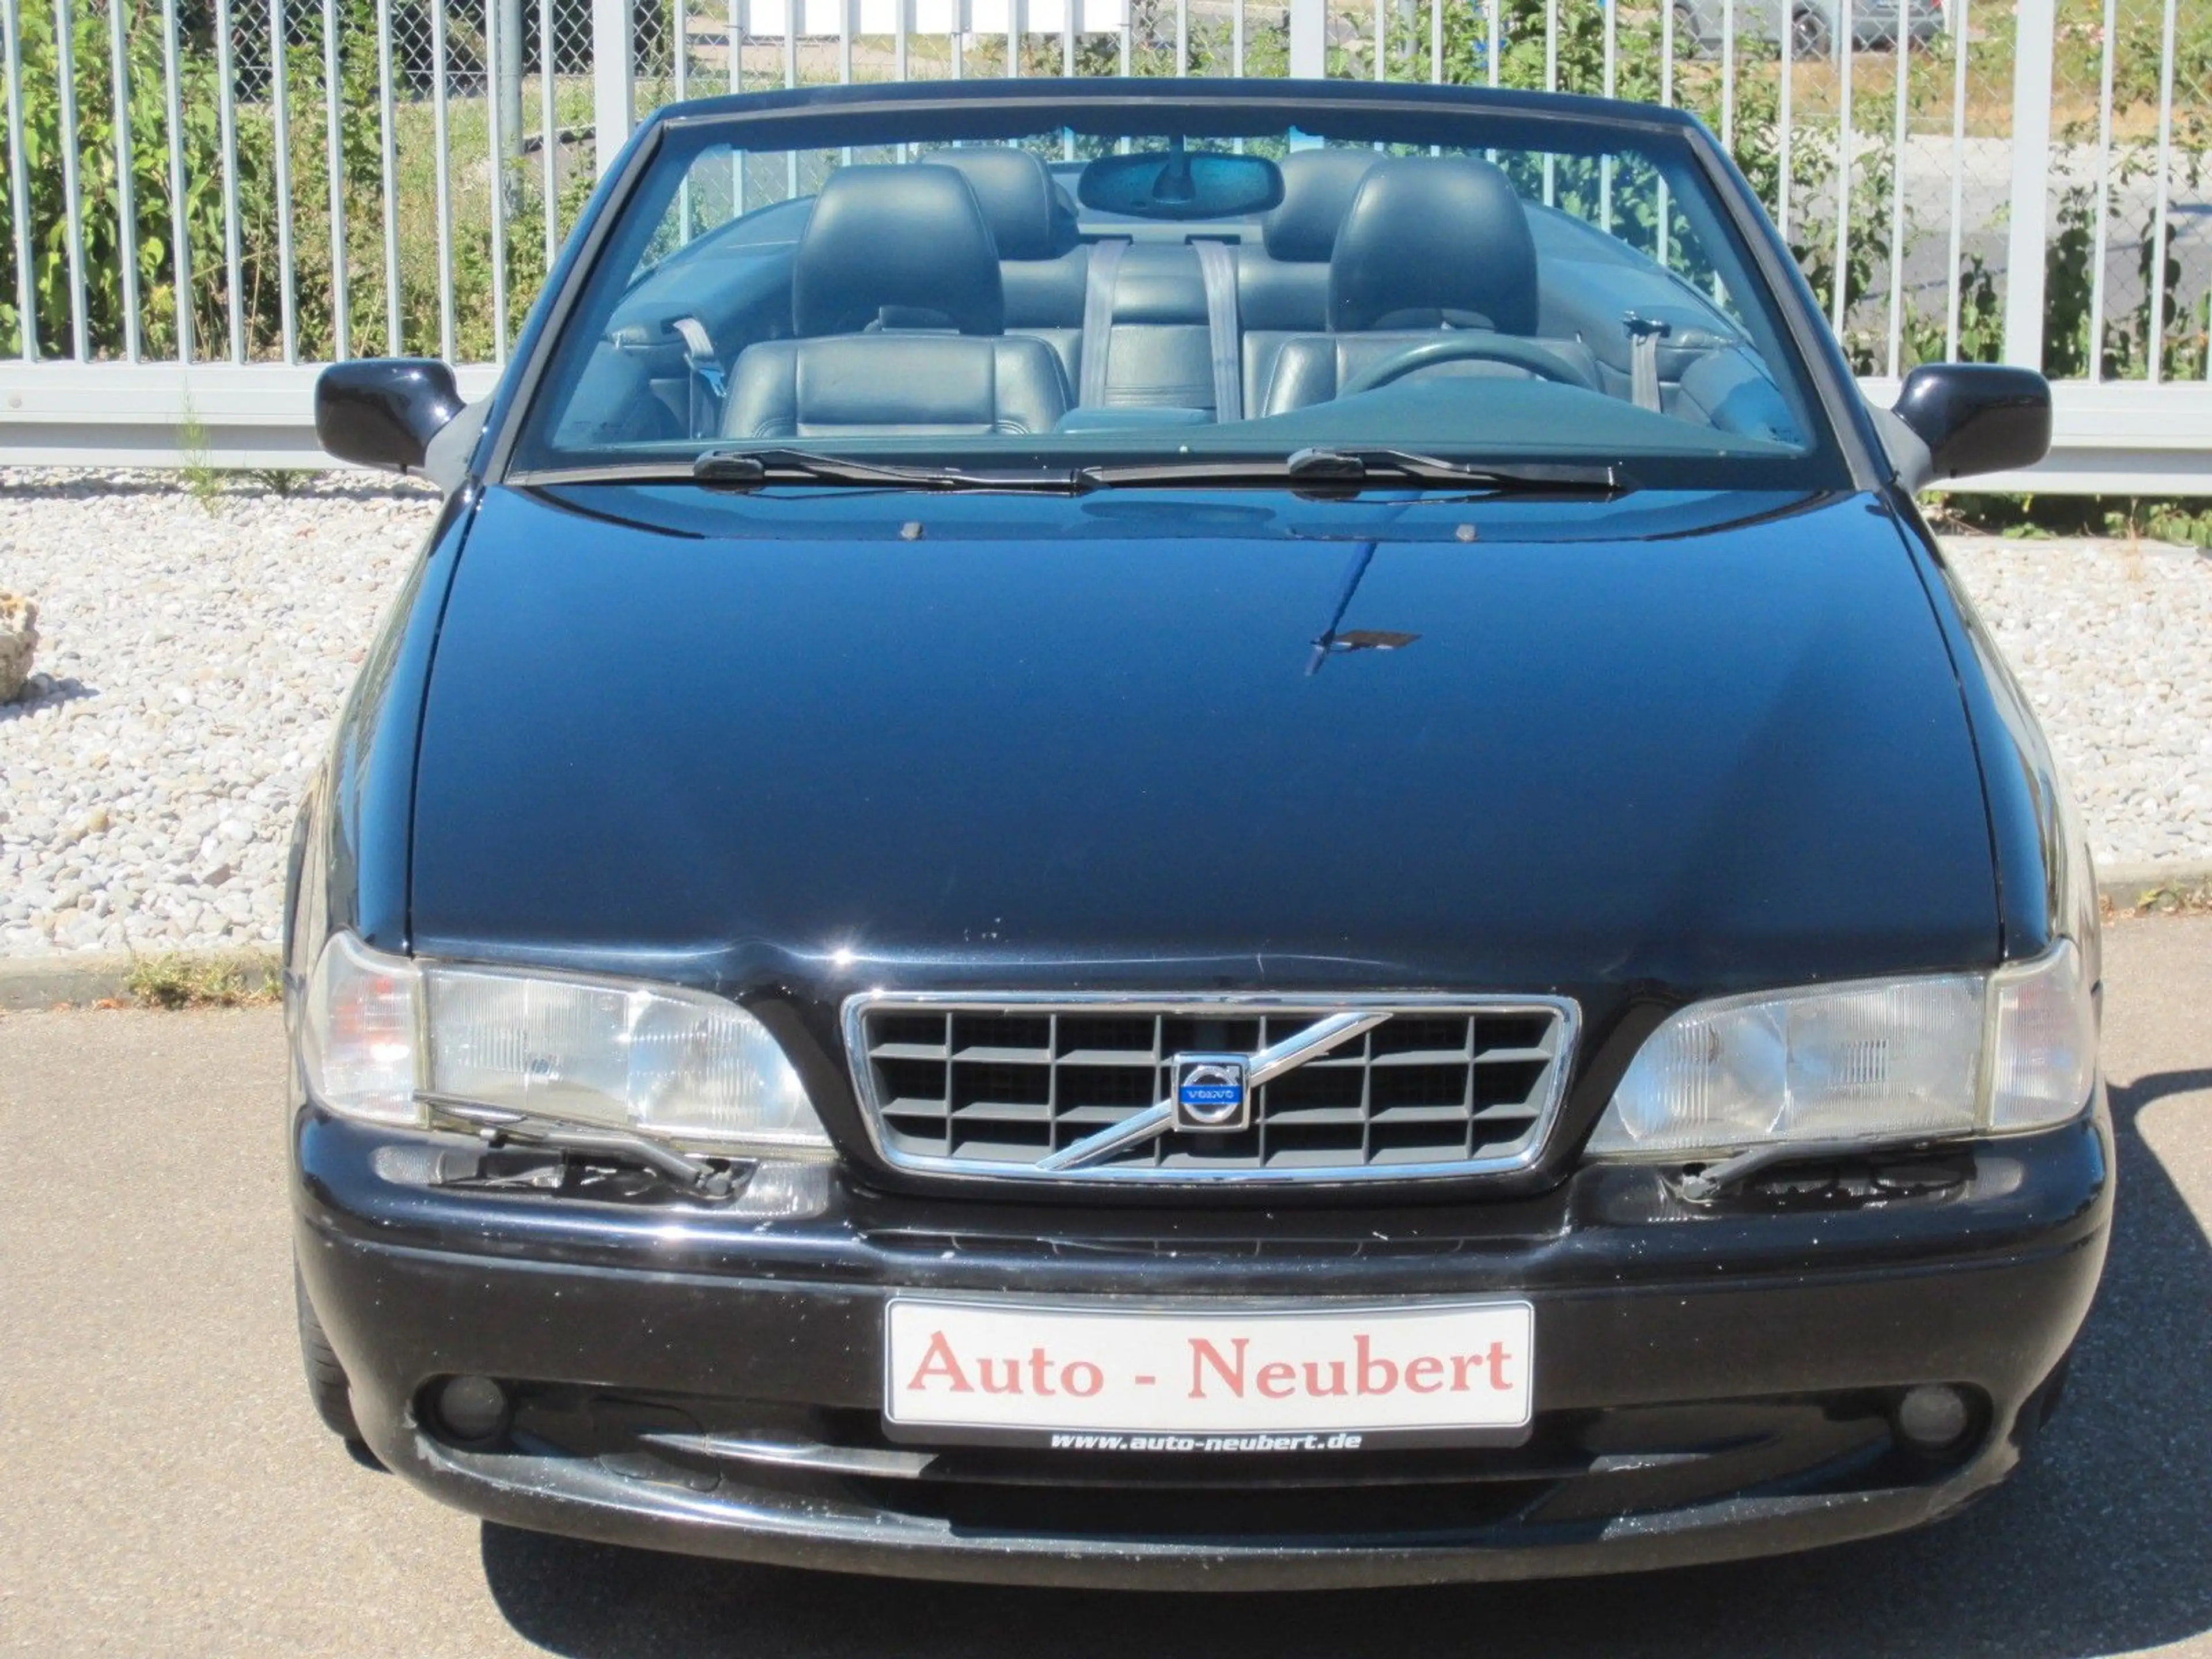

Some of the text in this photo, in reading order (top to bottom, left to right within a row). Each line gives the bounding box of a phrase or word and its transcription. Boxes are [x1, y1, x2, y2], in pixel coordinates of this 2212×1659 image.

[1187, 1090, 1234, 1099] VOLVO
[907, 1330, 1513, 1399] Auto - Neubert
[1050, 1433, 1362, 1452] www.auto-neubert.de
